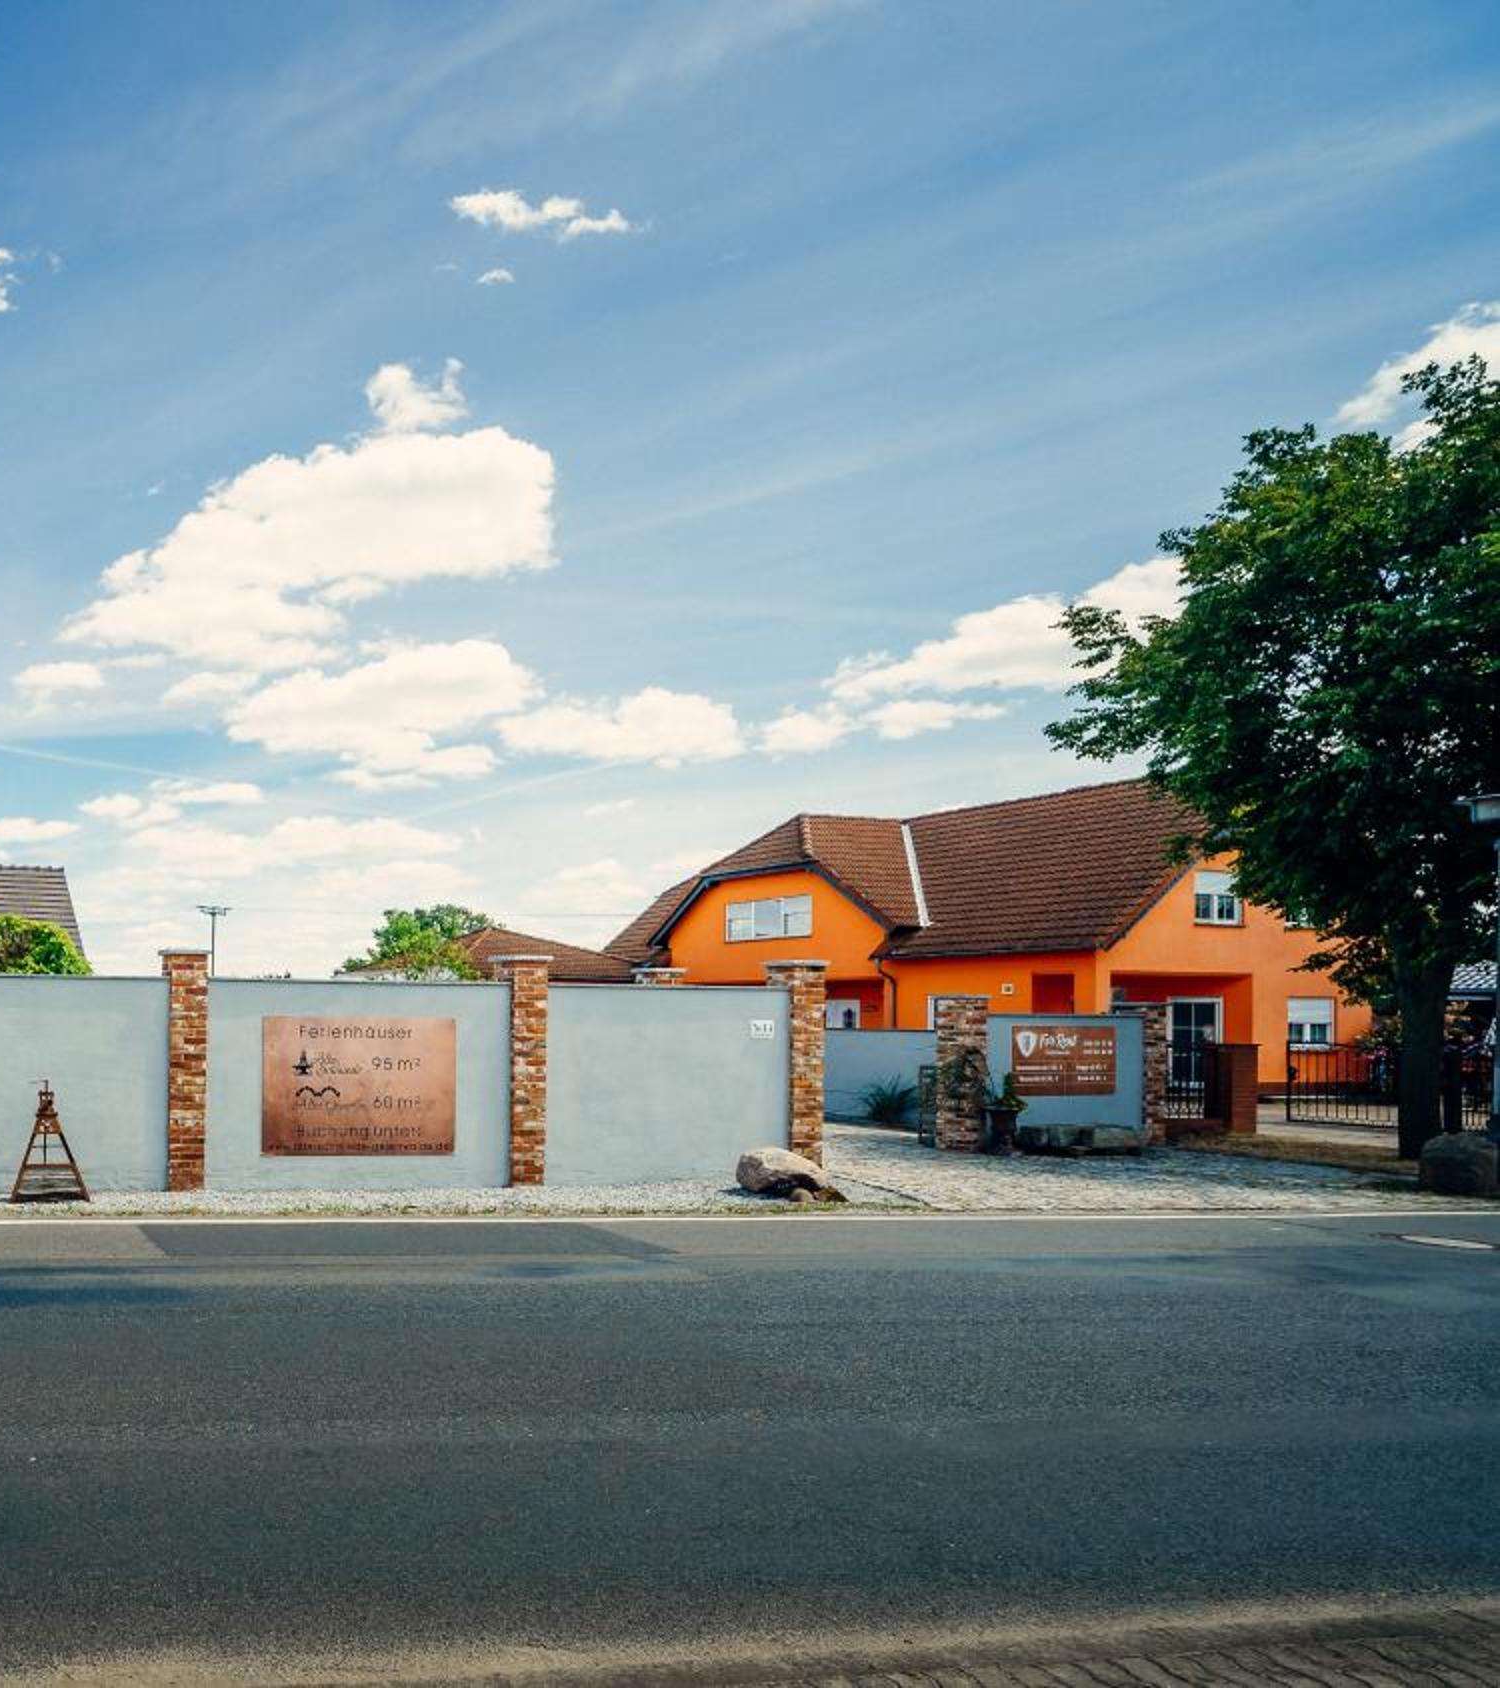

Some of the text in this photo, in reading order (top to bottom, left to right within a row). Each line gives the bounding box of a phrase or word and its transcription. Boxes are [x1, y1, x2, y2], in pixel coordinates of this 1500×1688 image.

[298, 1024, 412, 1040] Ferienhäuser
[371, 1056, 393, 1071] 95
[397, 1057, 421, 1072] m²
[372, 1095, 393, 1110] 60
